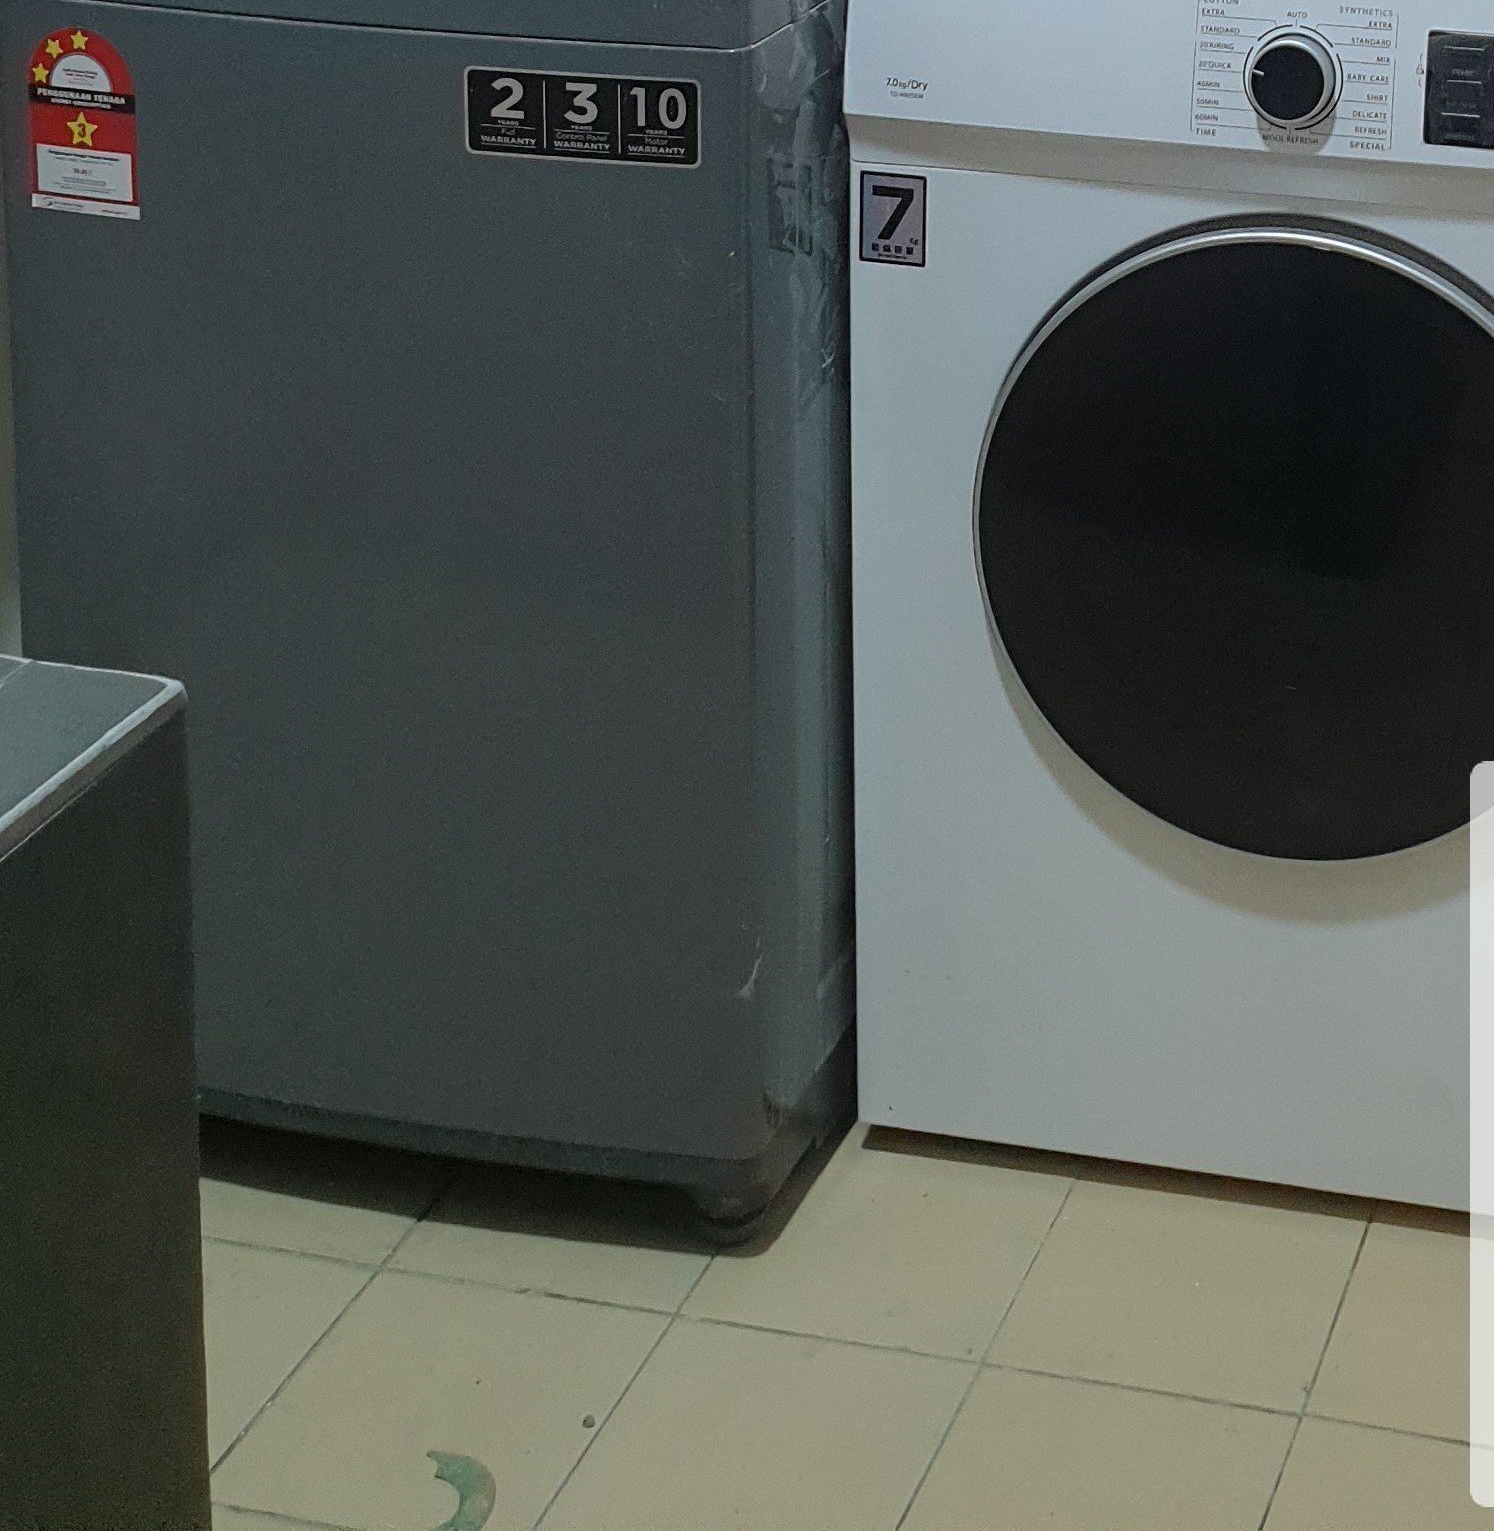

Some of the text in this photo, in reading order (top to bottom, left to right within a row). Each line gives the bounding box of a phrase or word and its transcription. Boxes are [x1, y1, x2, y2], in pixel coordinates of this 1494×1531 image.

[1202, 7, 1225, 16] EXTRA
[1286, 10, 1308, 19] AUTO
[1339, 5, 1394, 18] SYNTHETICS
[1200, 25, 1241, 35] STANDARD
[1368, 20, 1393, 29] EXTRA
[1351, 36, 1392, 47] STANDARD
[1346, 72, 1390, 83] BABY CARE
[490, 77, 525, 119] 2
[563, 81, 599, 124] 3
[1366, 93, 1389, 102] SHIRT
[630, 86, 687, 130] 10
[1352, 110, 1388, 120] DELICATE
[77, 123, 86, 138] 3
[1196, 128, 1217, 136] TIME
[1354, 126, 1388, 135] REFRESH
[480, 135, 537, 147] WARRANTY
[556, 132, 585, 141] Control
[644, 137, 669, 145] Motor
[1286, 134, 1319, 144] REFRESH
[553, 140, 611, 151] WARRANTY
[627, 144, 686, 156] WARRANTY
[1349, 140, 1386, 151] SPECIAL
[872, 184, 915, 240] 7
